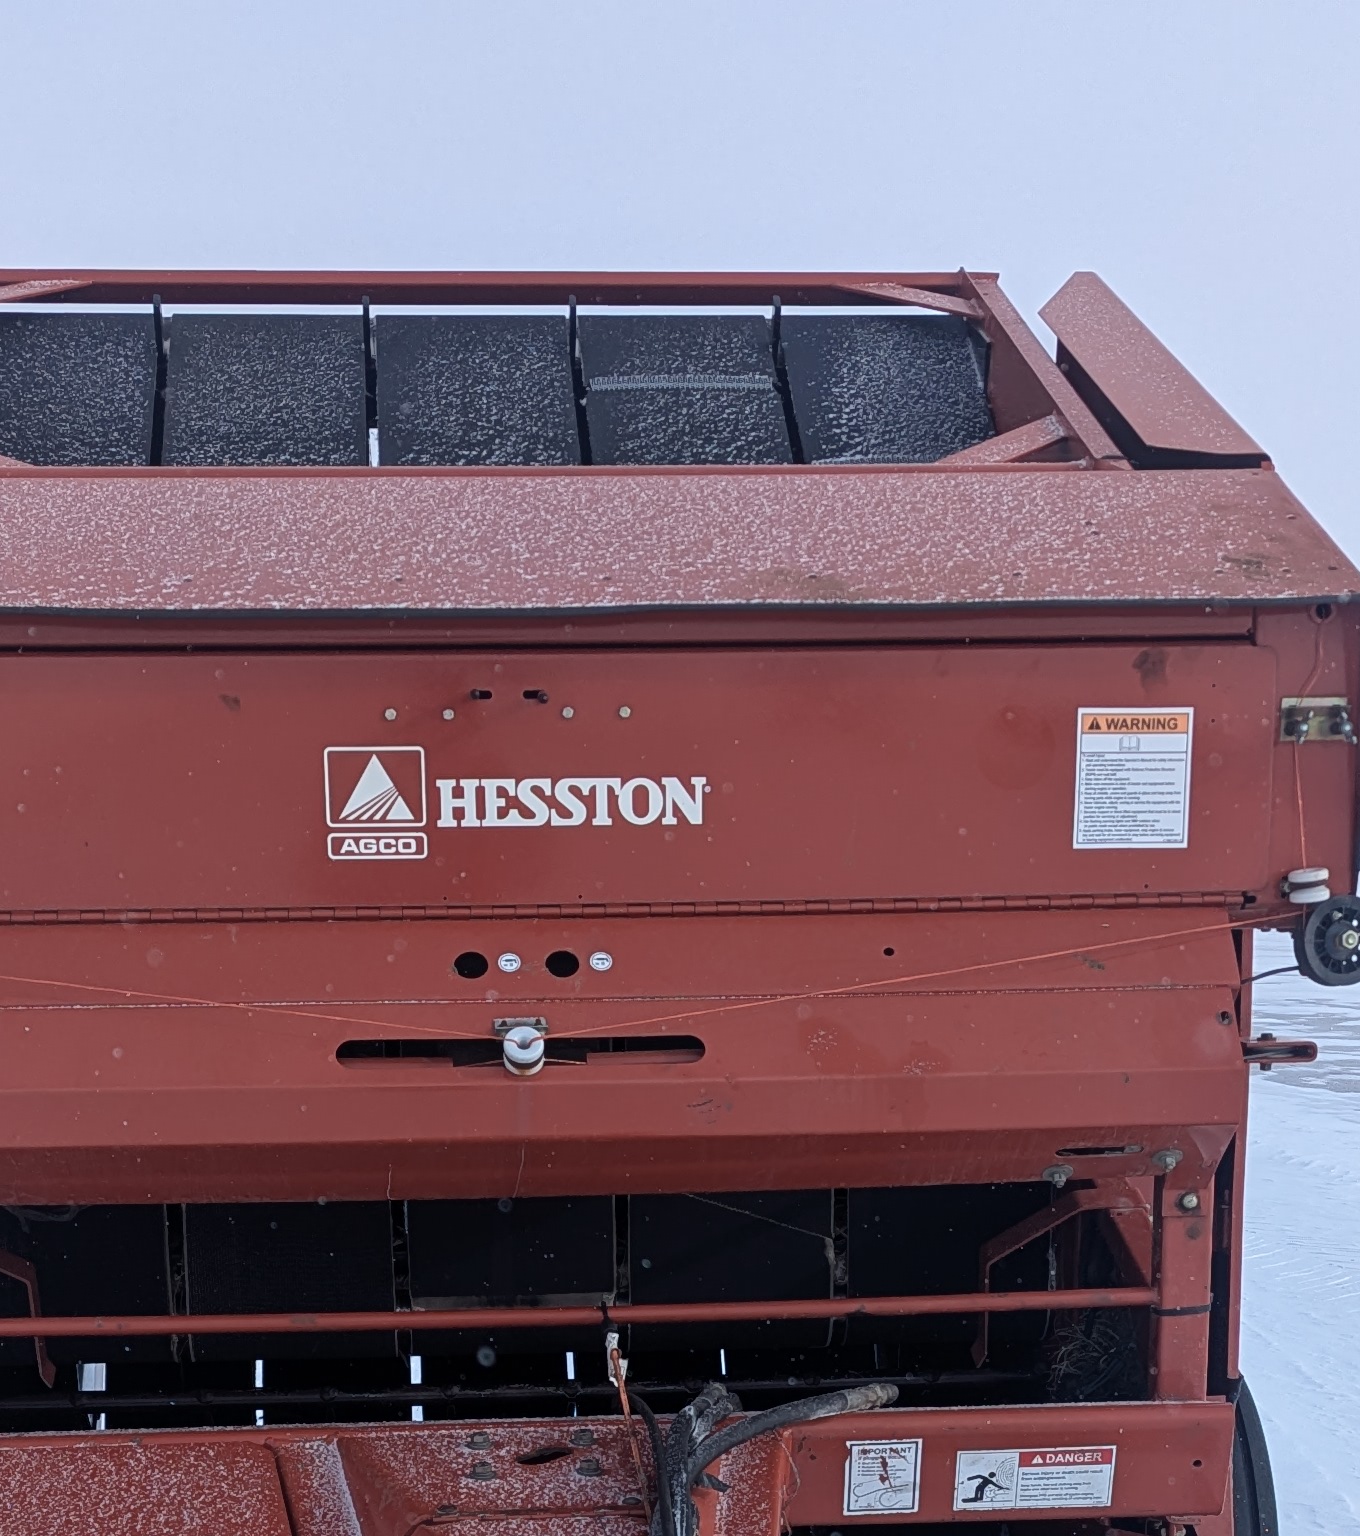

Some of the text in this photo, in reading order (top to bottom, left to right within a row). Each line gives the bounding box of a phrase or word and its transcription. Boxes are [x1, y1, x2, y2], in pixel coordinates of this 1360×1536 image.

[1105, 717, 1178, 730] WARNING
[436, 776, 707, 828] HESSTON
[339, 837, 417, 854] AGCO
[1045, 1452, 1102, 1464] DANGER
